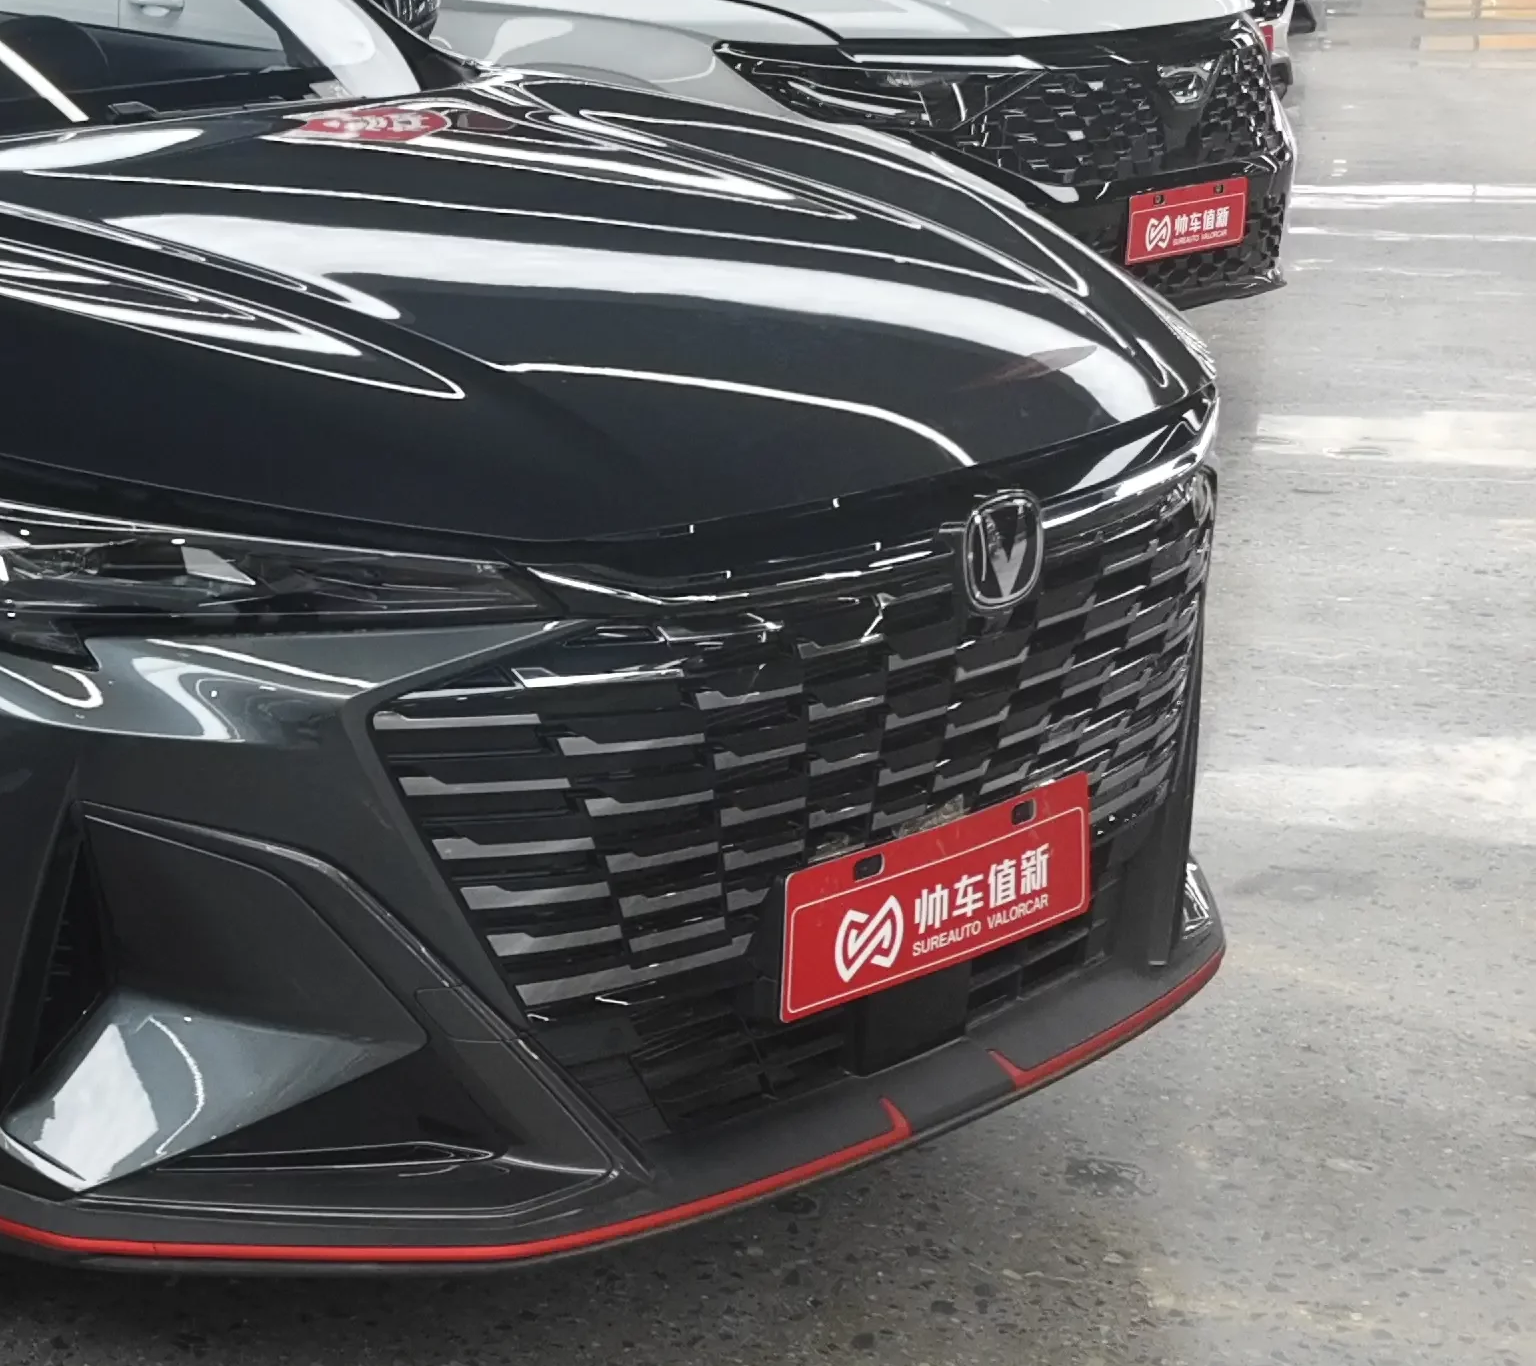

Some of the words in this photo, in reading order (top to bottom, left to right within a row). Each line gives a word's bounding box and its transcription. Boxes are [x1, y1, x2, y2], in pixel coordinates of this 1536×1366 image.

[1174, 206, 1230, 235] 帅车值新
[913, 842, 1051, 935] 帅车值新
[911, 920, 982, 957] SUREAUTO
[986, 893, 1050, 930] VALORCAR
